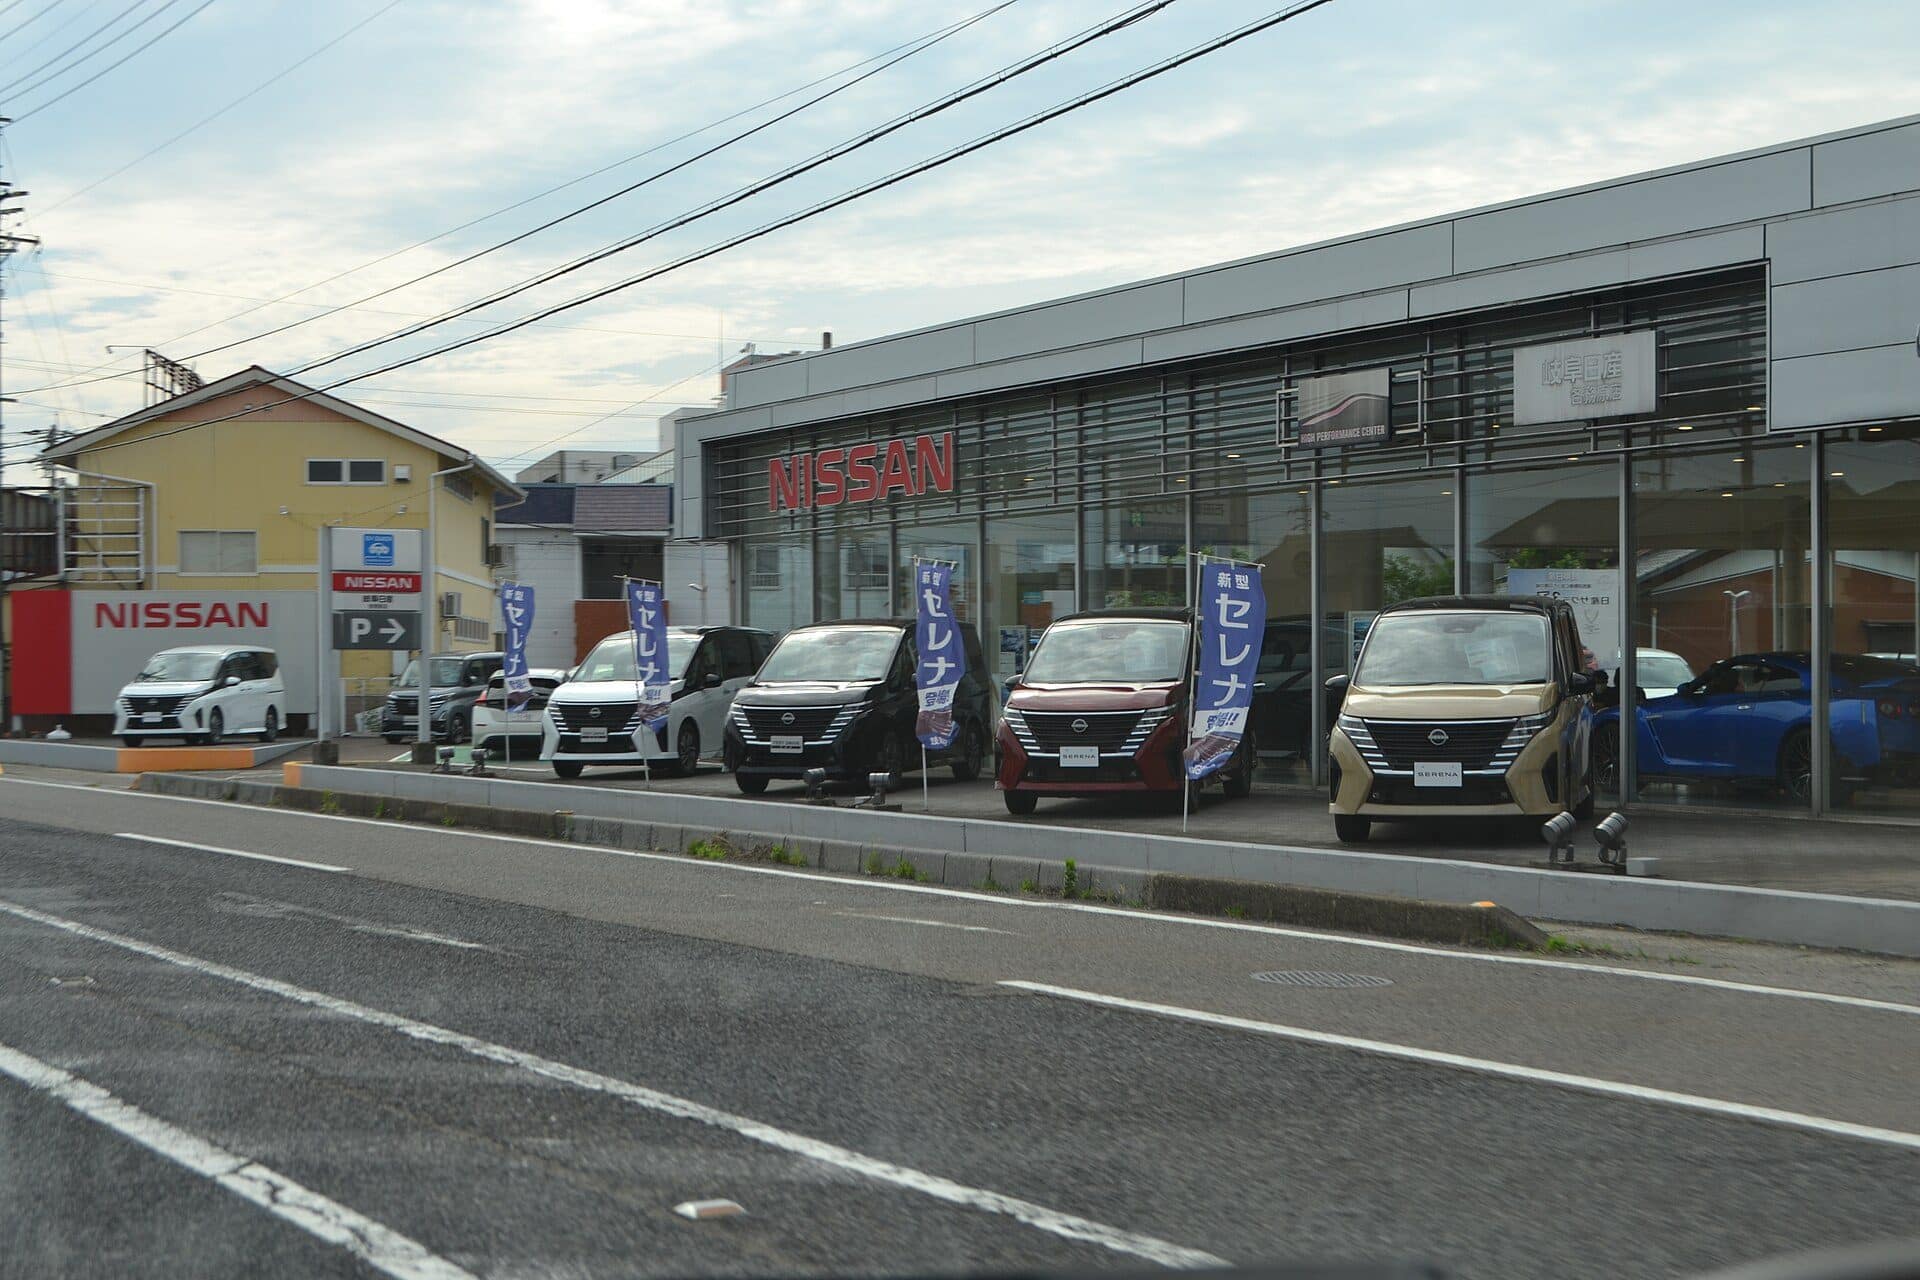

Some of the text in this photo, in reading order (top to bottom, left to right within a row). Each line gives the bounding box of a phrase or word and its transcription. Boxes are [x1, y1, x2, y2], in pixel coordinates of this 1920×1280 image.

[1542, 351, 1622, 384] 岐阜日産
[1301, 425, 1385, 443] HIGH PERFORMANCE CENTER
[769, 432, 953, 512] NISSAN
[345, 577, 413, 589] NISSAN
[921, 571, 944, 586] 新型
[1217, 572, 1250, 590] 新型
[95, 602, 269, 628] NISSAN
[351, 618, 371, 643] P
[505, 602, 525, 674] セレナ
[638, 605, 660, 682] セレナ
[923, 589, 956, 685] セレナ
[1212, 593, 1252, 707] セレナ
